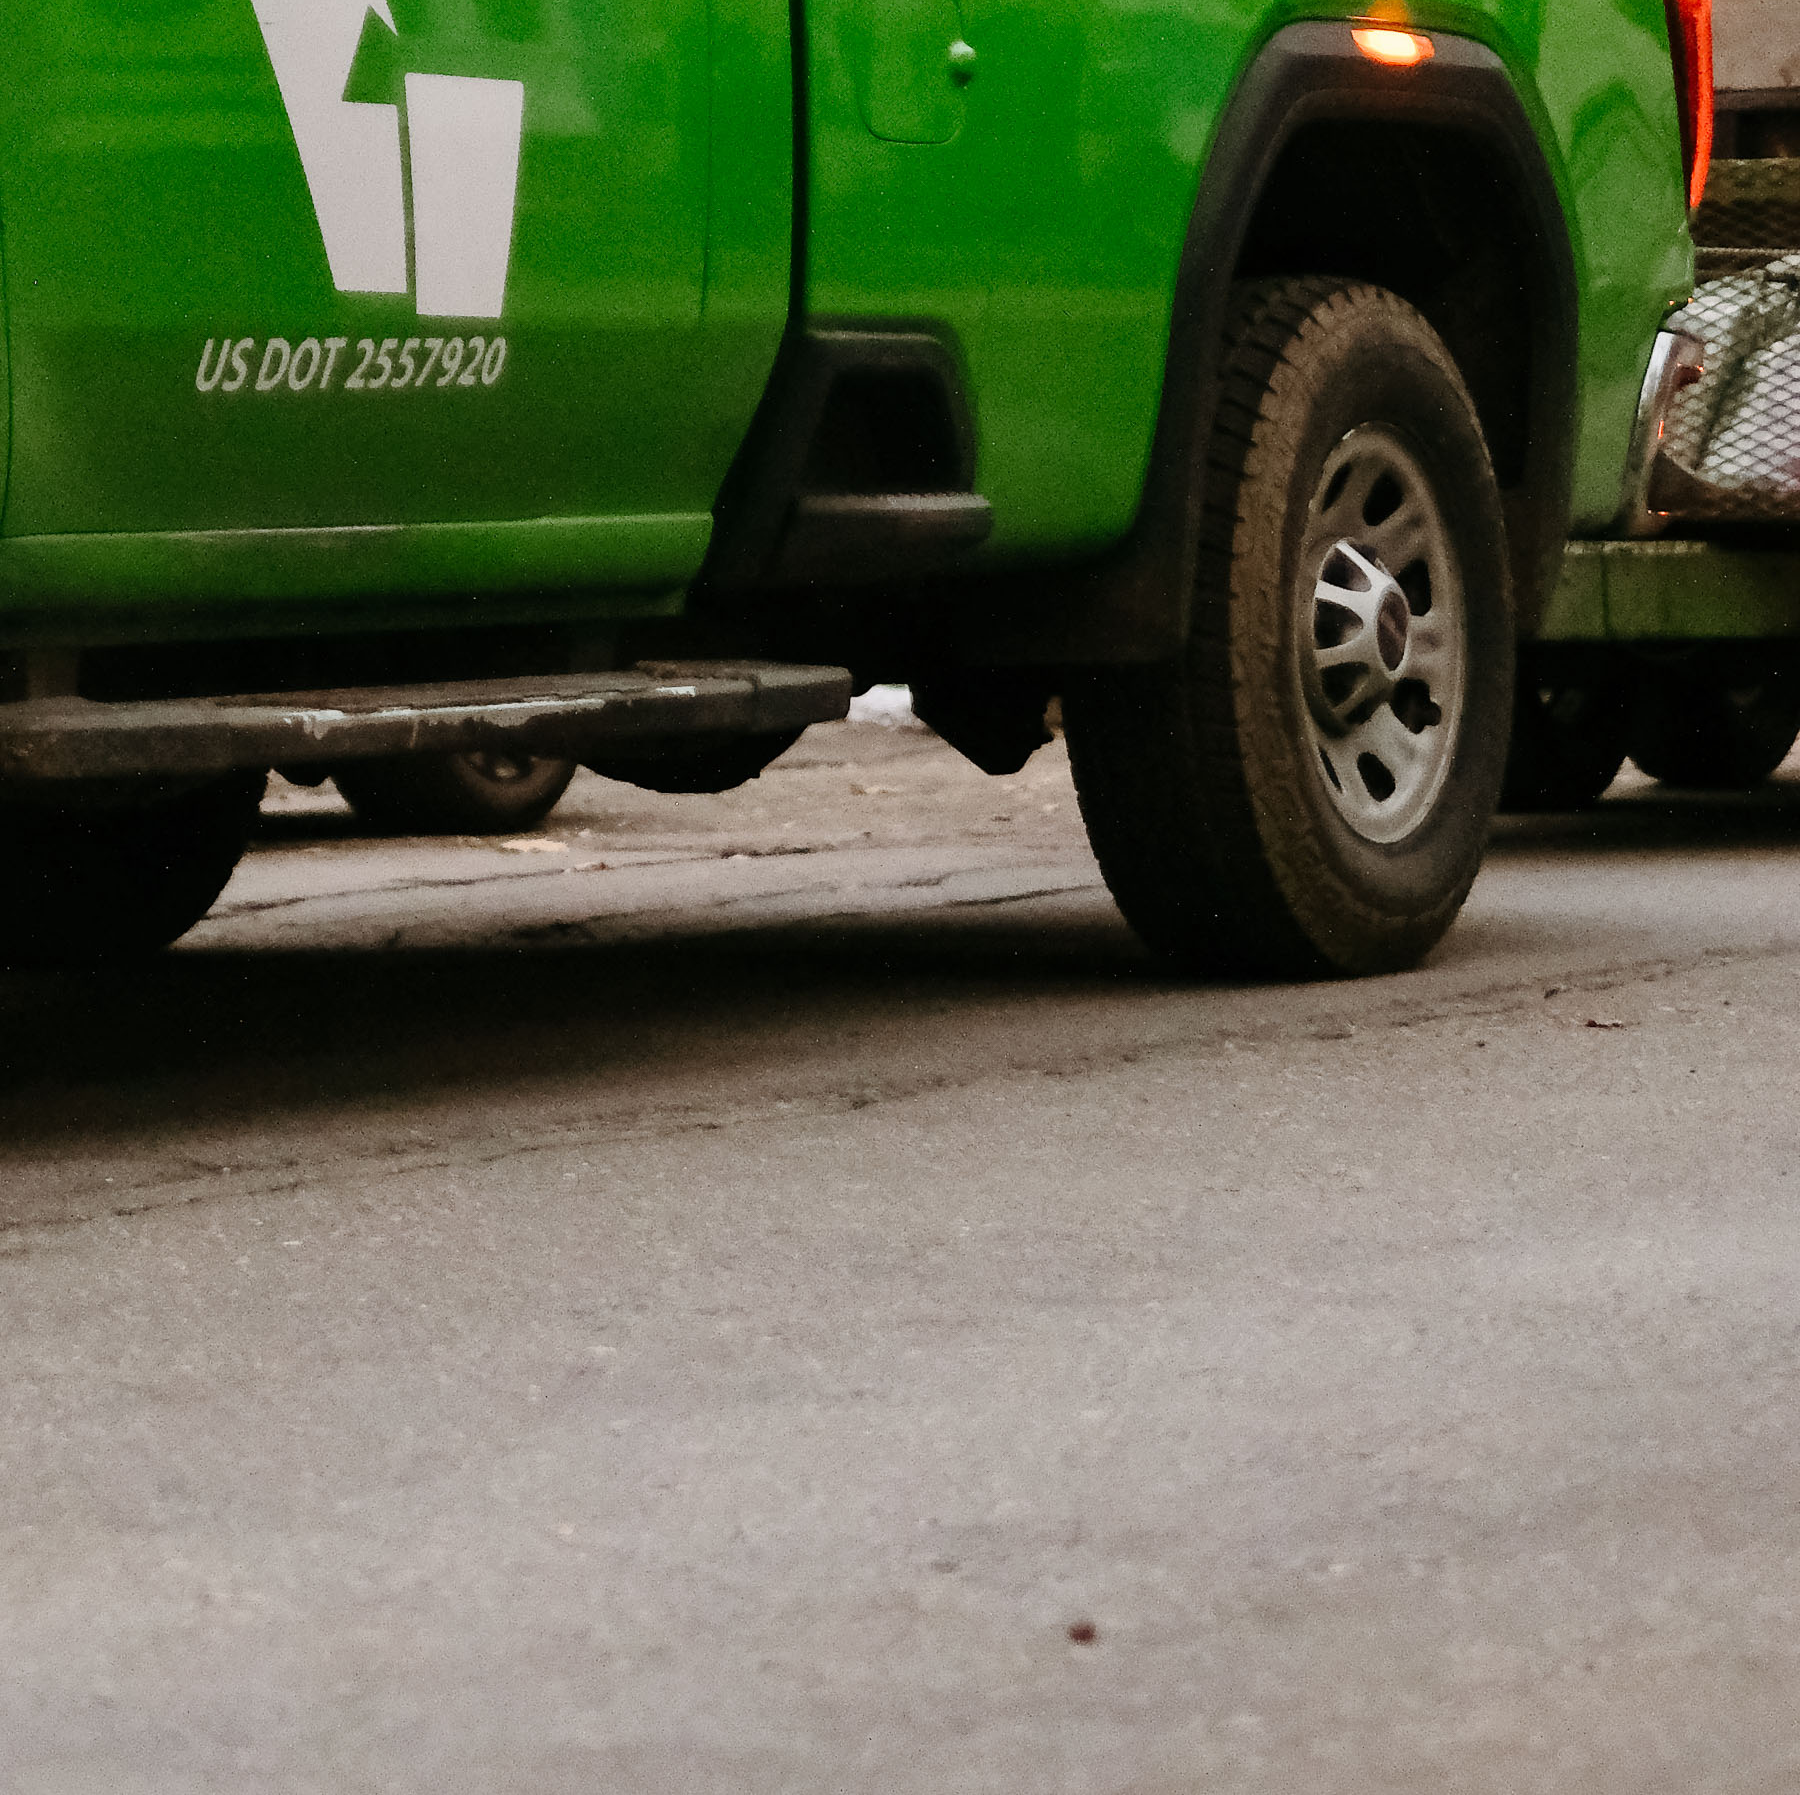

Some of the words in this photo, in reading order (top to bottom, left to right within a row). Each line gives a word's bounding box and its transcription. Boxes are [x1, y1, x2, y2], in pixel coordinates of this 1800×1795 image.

[195, 336, 255, 392] US
[255, 336, 348, 391] DOT
[344, 335, 507, 389] 2557920
